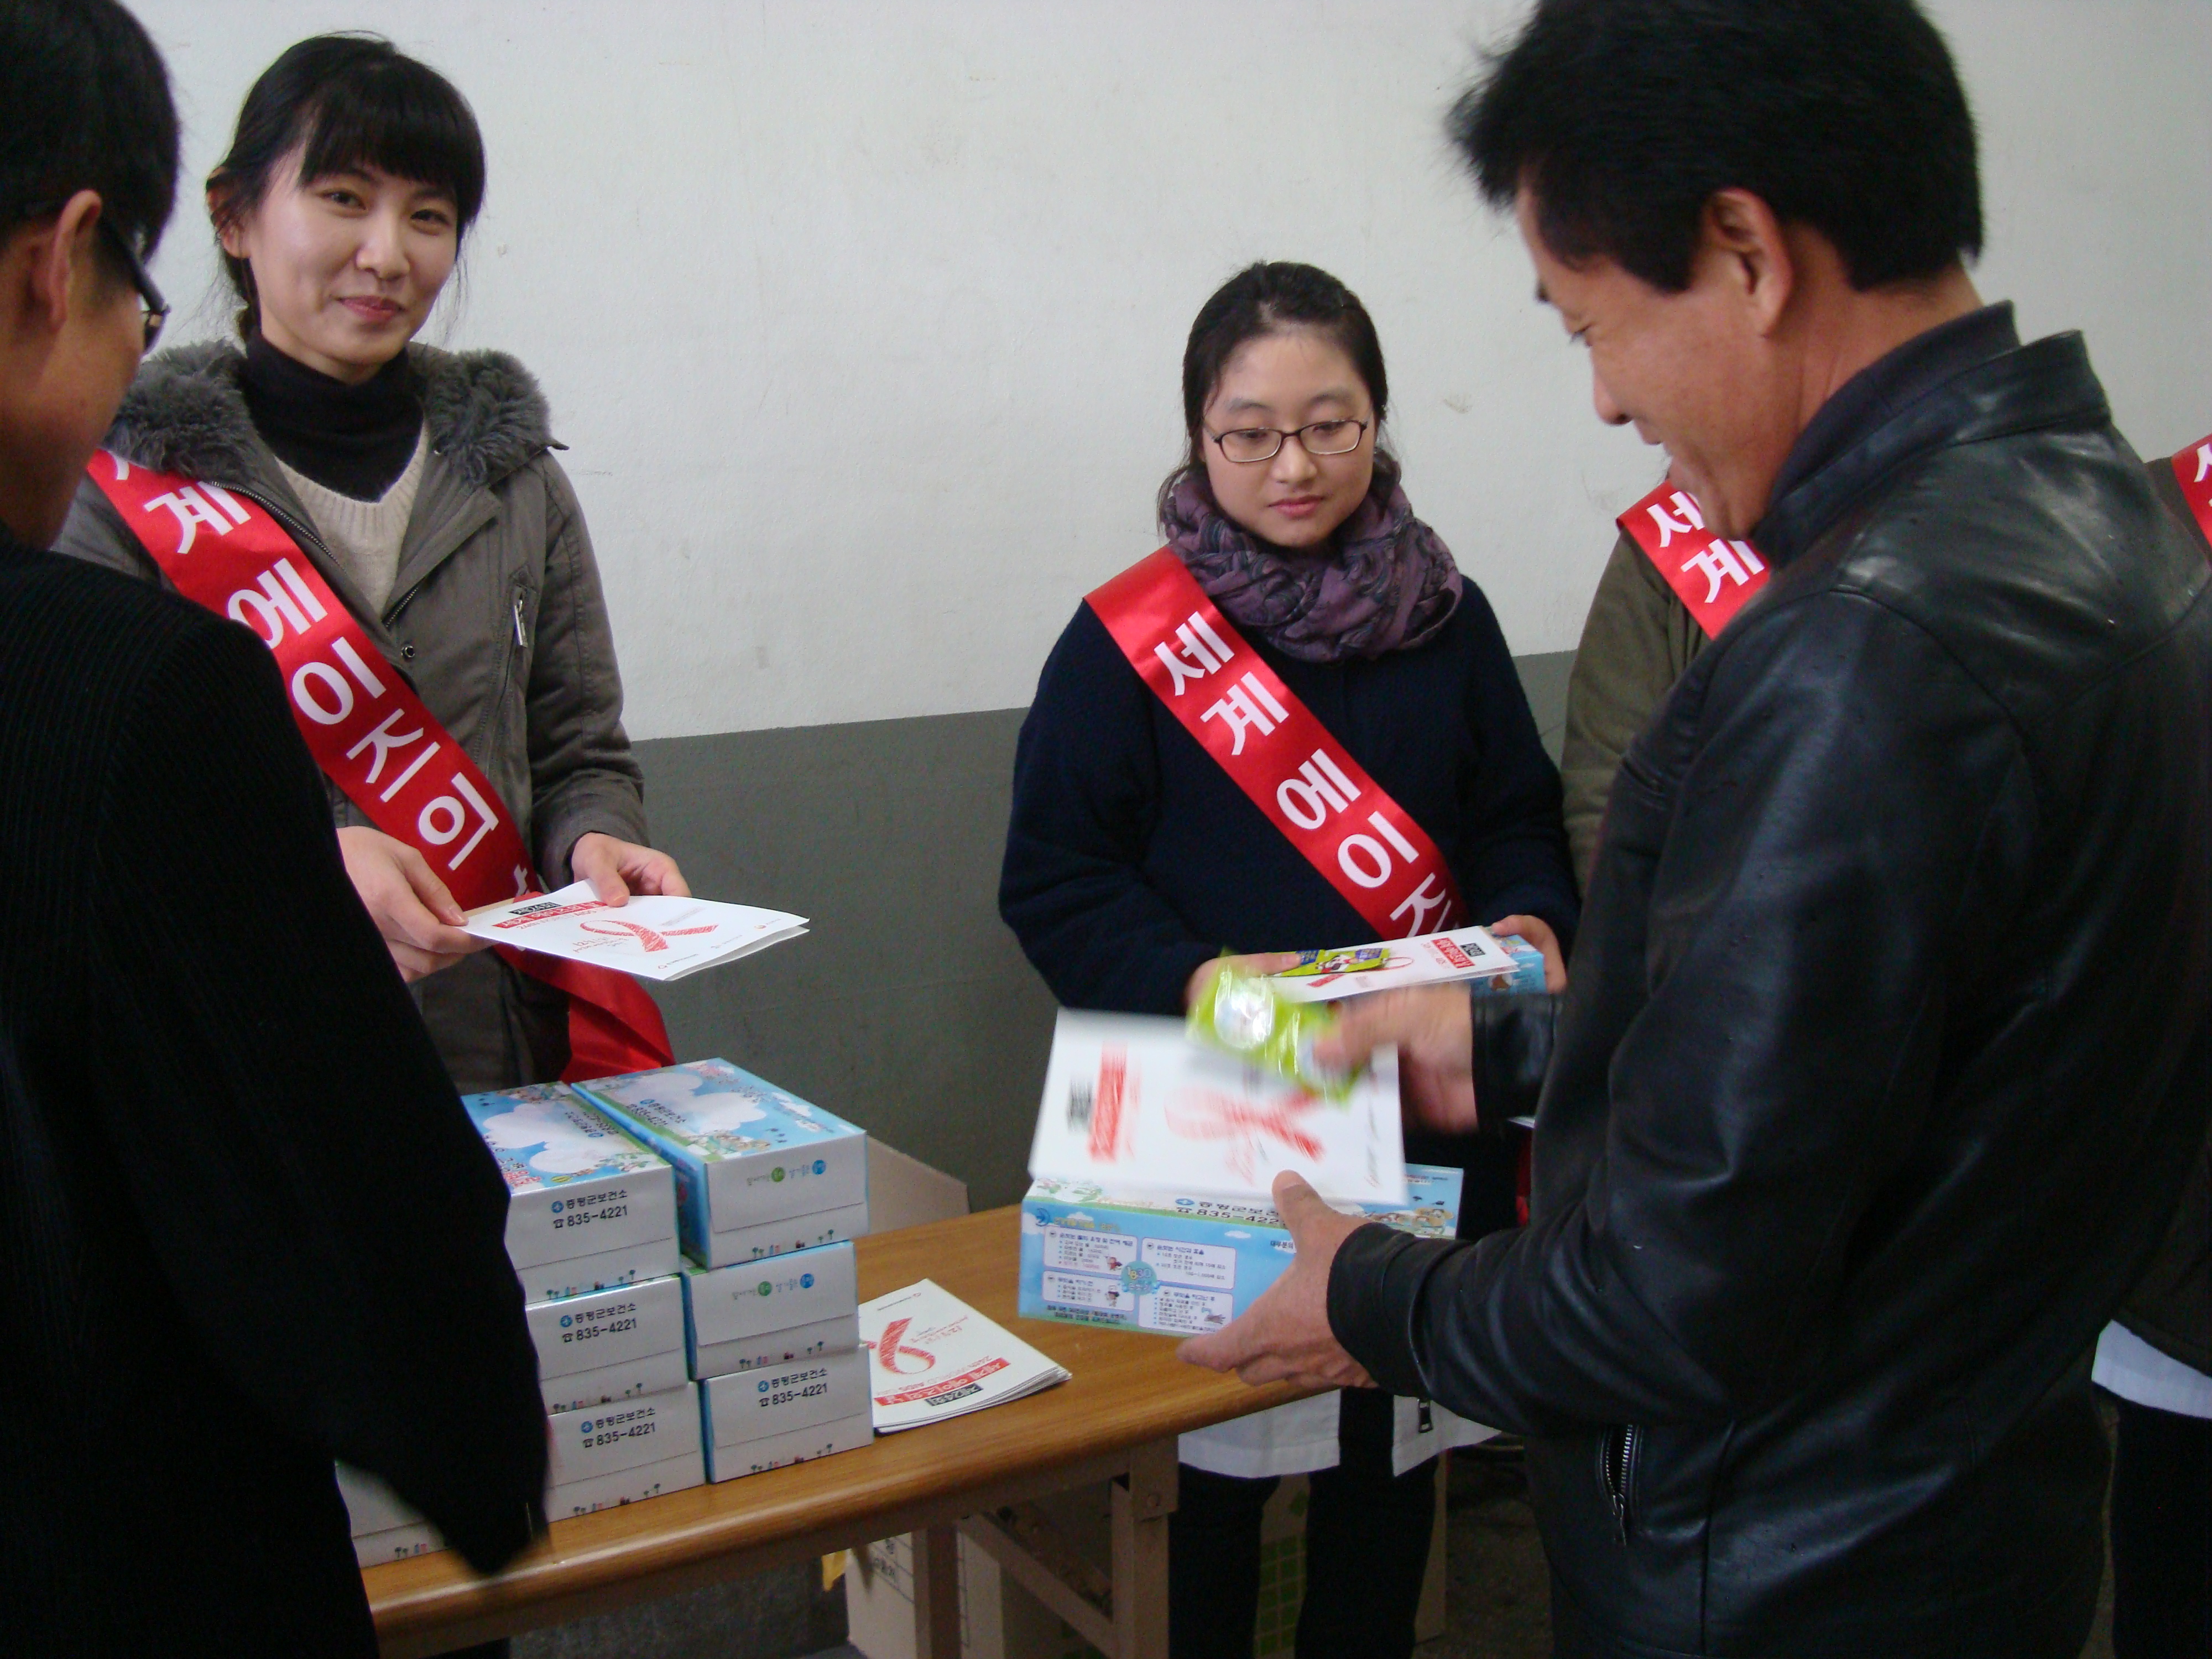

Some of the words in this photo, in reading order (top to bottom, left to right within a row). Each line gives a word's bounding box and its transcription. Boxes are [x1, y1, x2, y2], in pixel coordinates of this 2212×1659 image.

[227, 557, 499, 871] 에이즈의
[1154, 611, 1290, 756] 세계
[1276, 748, 1461, 938] 에이즈
[566, 1189, 628, 1209] 증평군보건소
[567, 1204, 628, 1227] 835-4221
[574, 1301, 638, 1325] 증평군보건소
[575, 1317, 638, 1343] 835-4221
[771, 1366, 828, 1390] 증평군보건소
[971, 1361, 1002, 1379] 세계
[771, 1383, 828, 1406] 835-4221
[907, 1377, 969, 1400] 에이즈의
[595, 1406, 656, 1430] 증평군보건소
[596, 1422, 656, 1447] 835-4221
